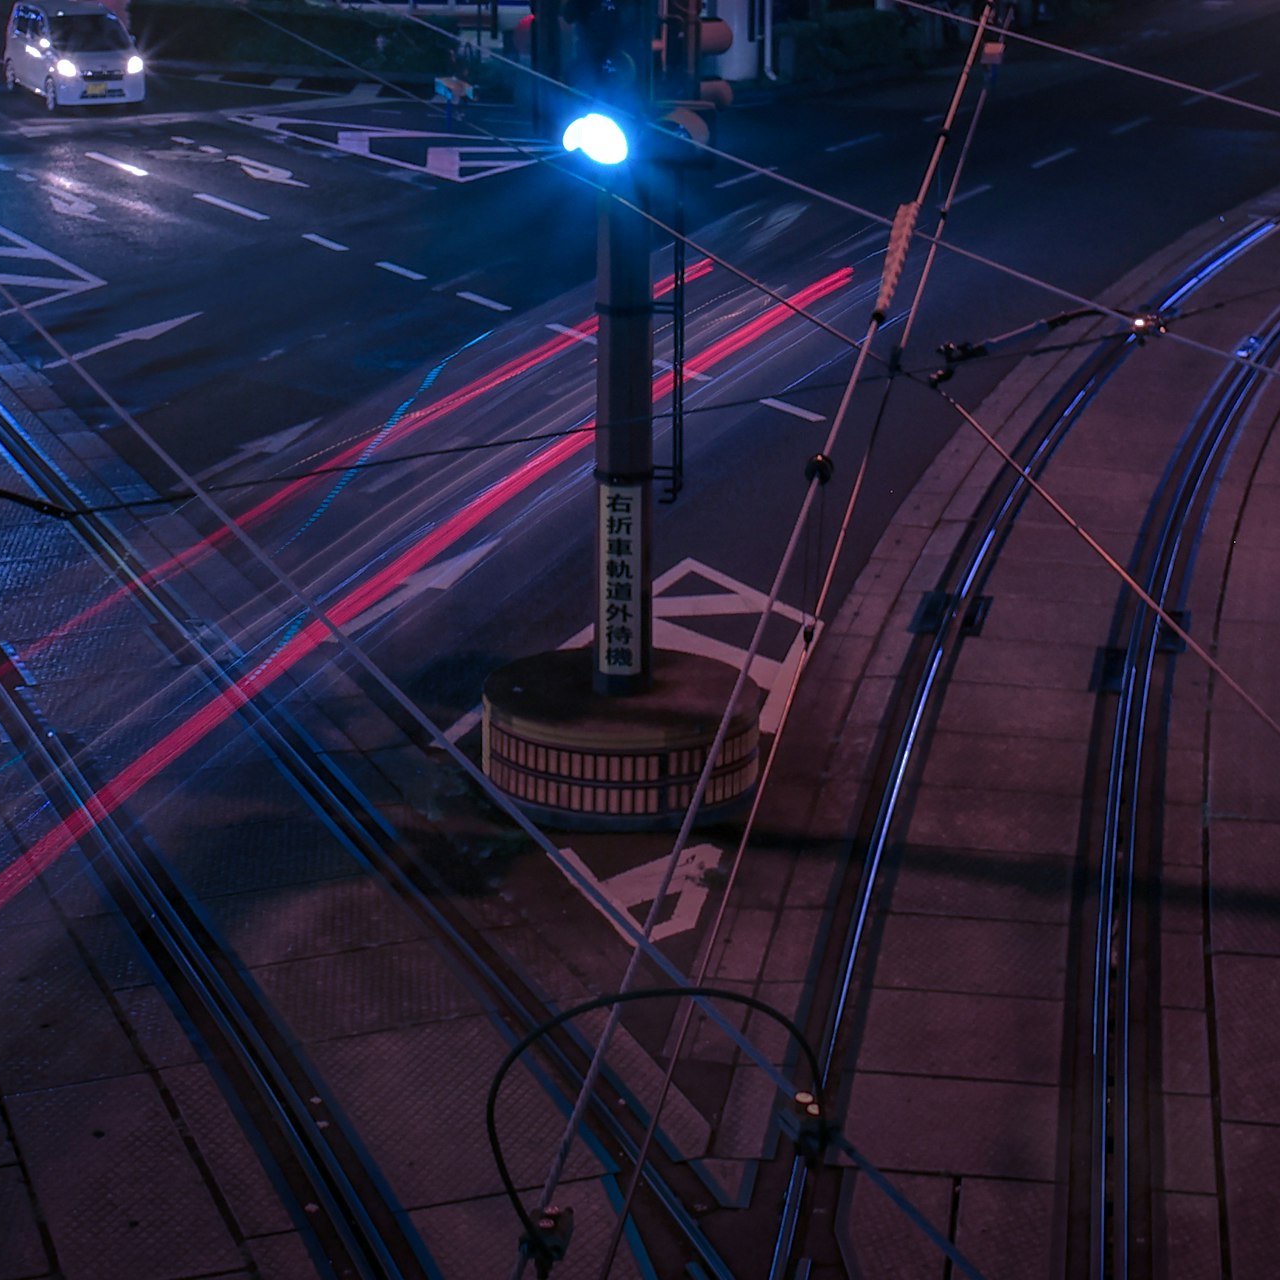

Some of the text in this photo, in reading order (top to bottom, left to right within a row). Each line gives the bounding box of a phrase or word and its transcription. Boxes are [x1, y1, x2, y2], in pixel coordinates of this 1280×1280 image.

[605, 493, 633, 668] 右折車軌道外待機
